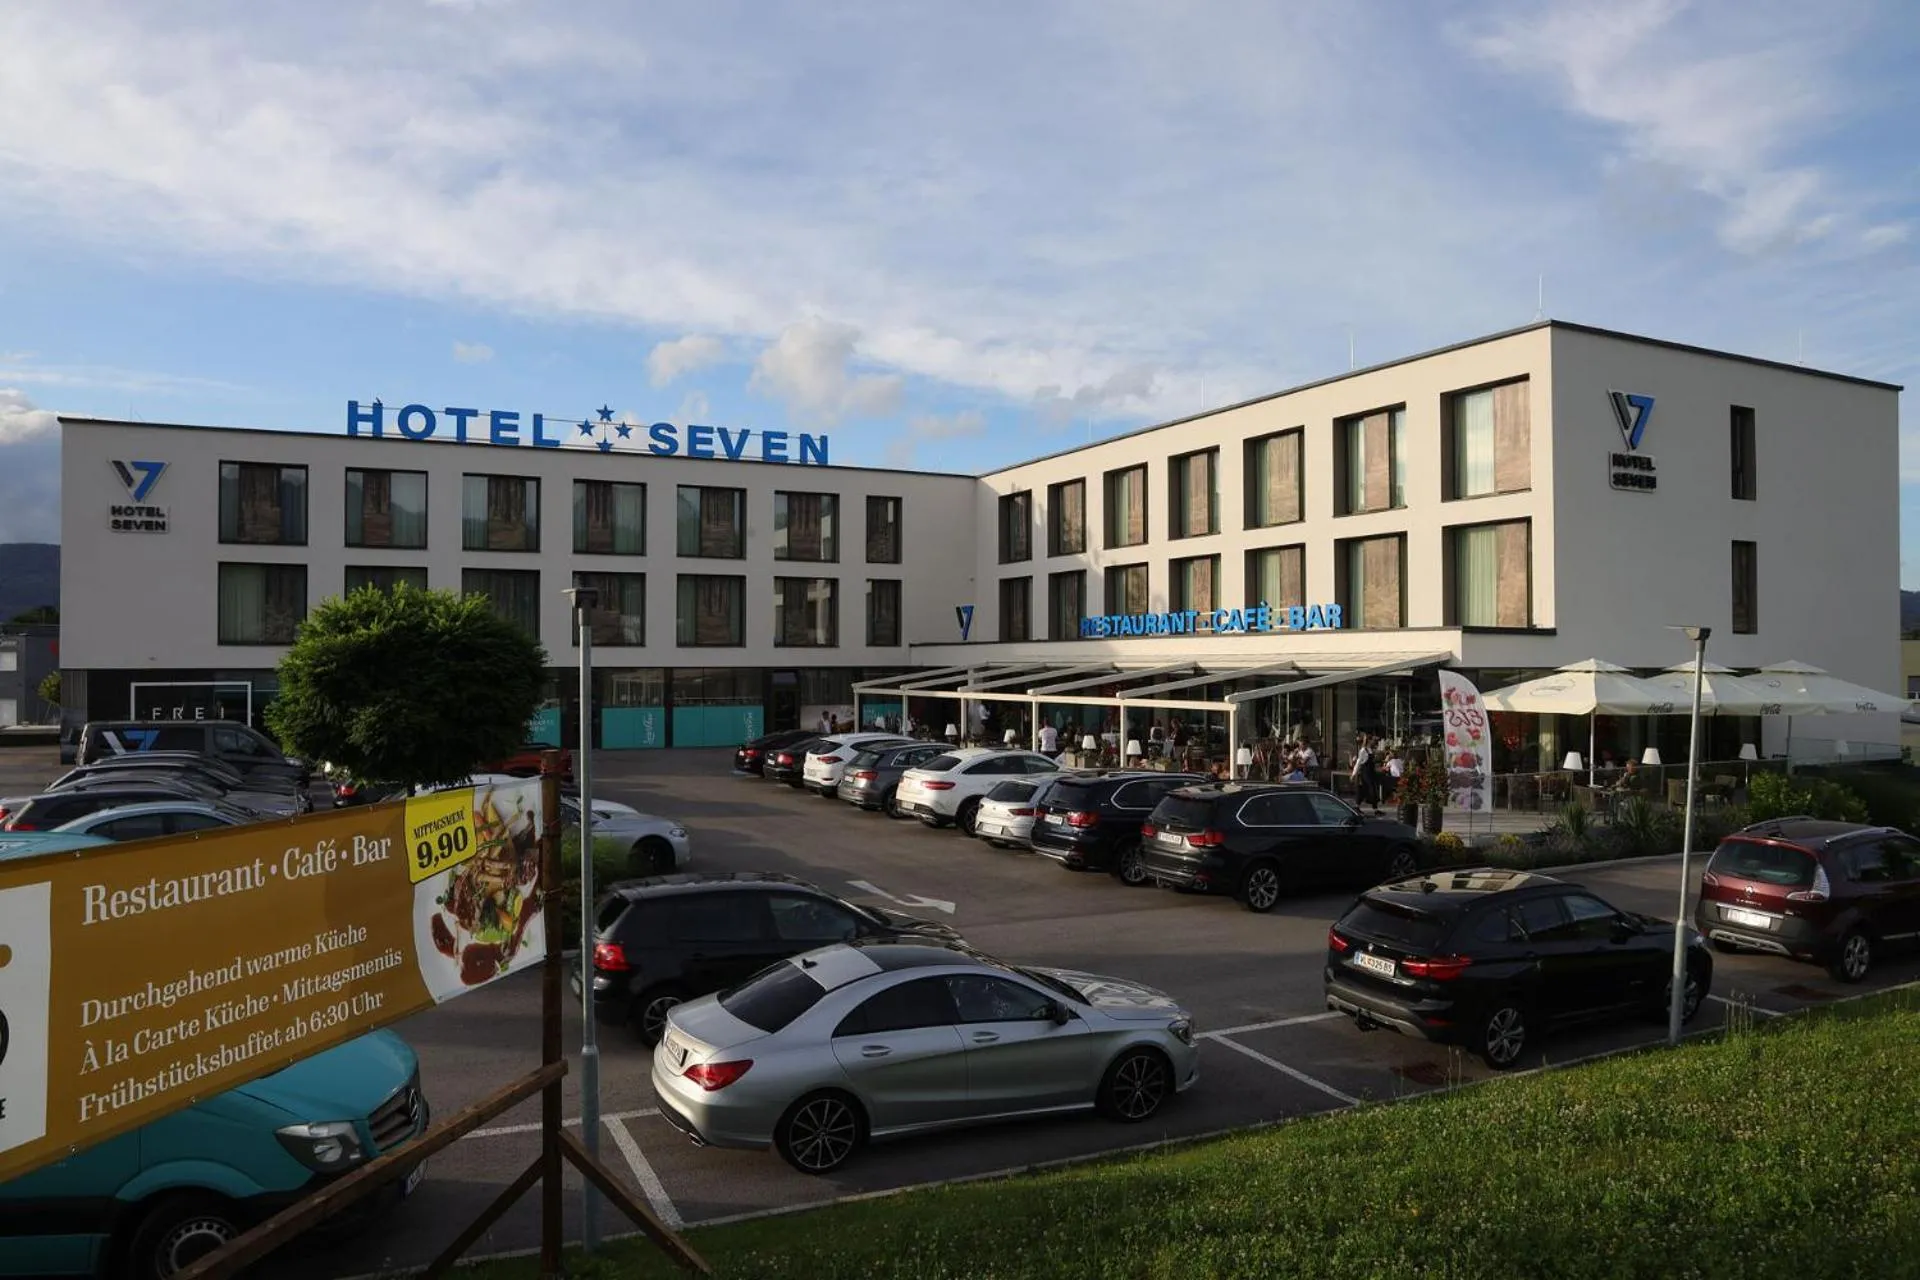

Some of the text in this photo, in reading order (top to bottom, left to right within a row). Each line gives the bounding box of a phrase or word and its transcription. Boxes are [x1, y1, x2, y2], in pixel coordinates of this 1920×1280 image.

[347, 400, 829, 465] HOTEL SEVEN
[111, 505, 166, 518] HOTEL
[111, 519, 166, 531] SEVEN
[1080, 609, 1198, 637] RESTAURANT
[1289, 603, 1342, 630] BAR
[417, 826, 468, 868] 9,90
[82, 835, 392, 925] Restaurant Café Bar
[80, 925, 367, 1028] Durchgehend warme Küche
[80, 948, 403, 1075] À la Carte Küche Mittagsmenüs
[79, 991, 384, 1123] Frühstücksbuffet ab 6:30 Uhr
